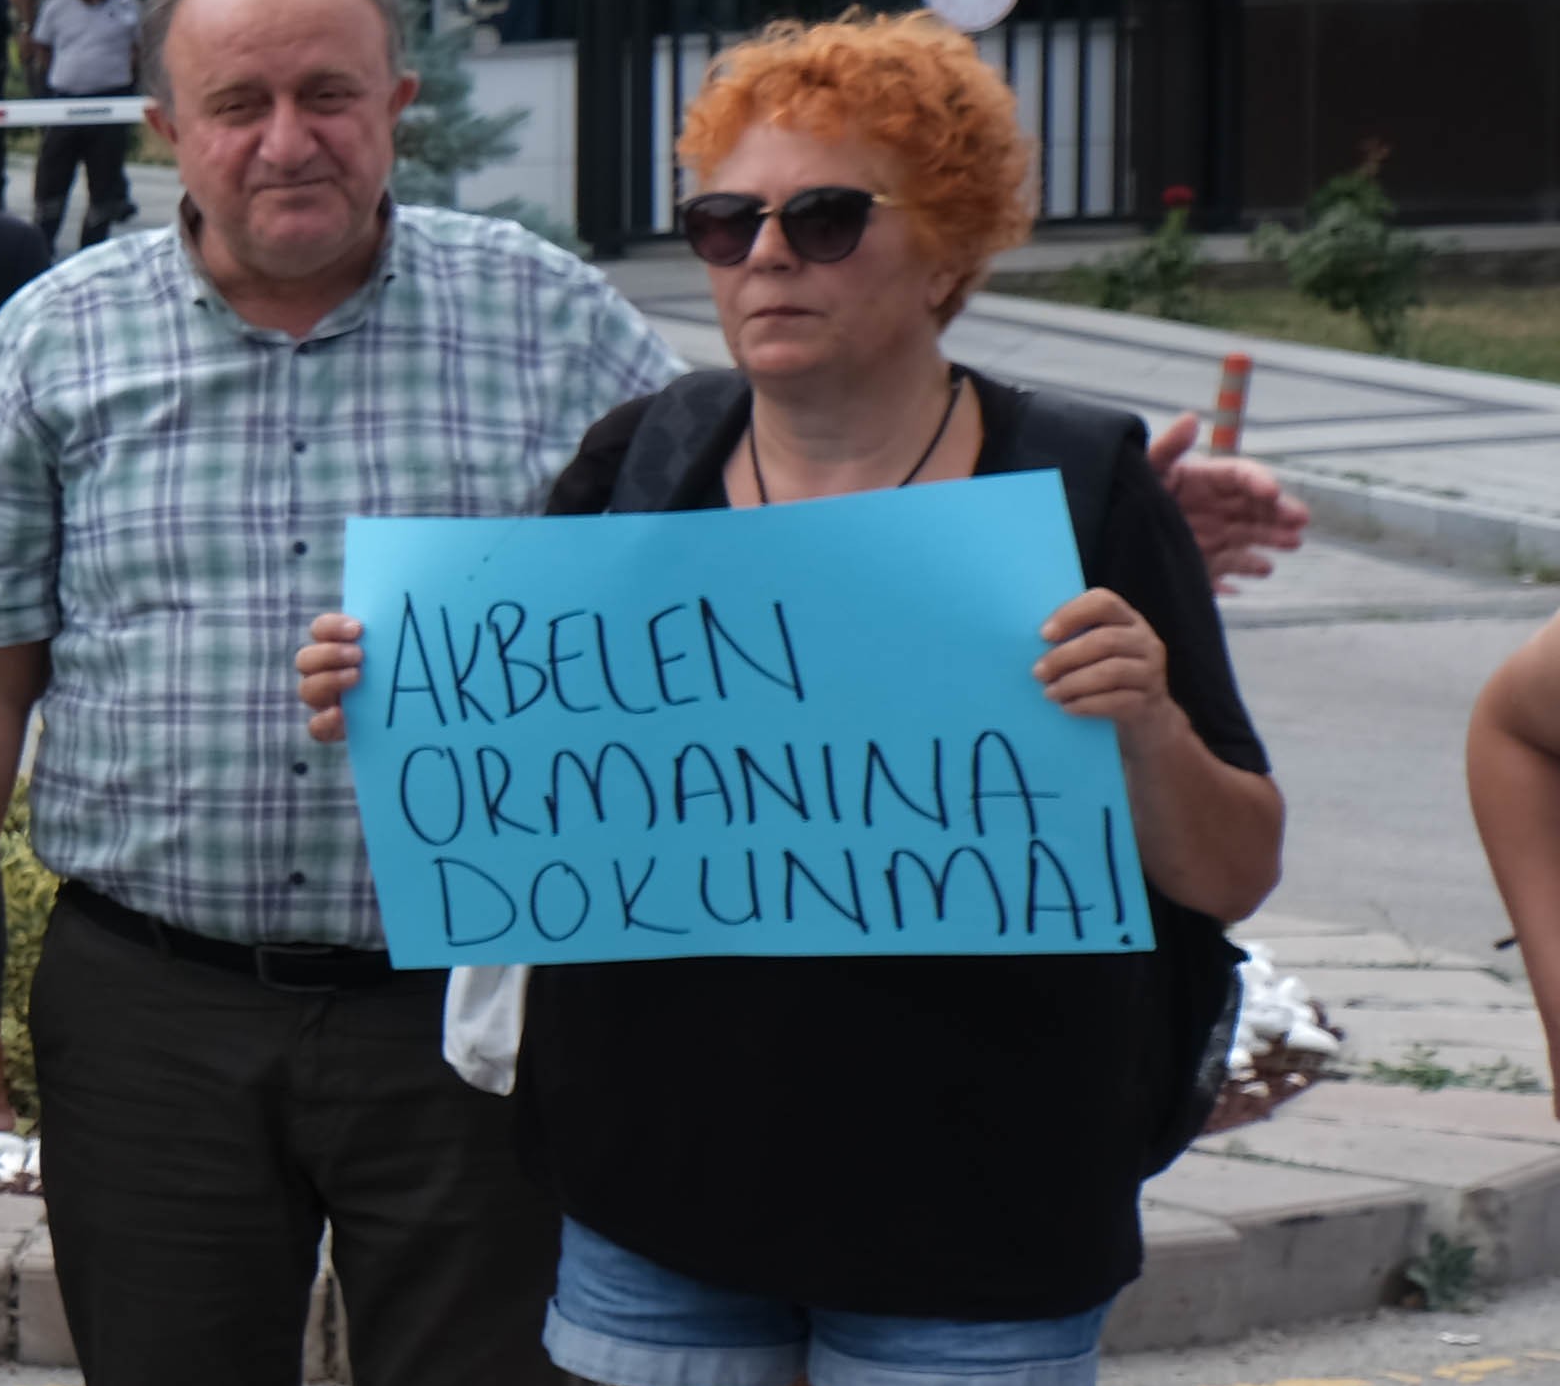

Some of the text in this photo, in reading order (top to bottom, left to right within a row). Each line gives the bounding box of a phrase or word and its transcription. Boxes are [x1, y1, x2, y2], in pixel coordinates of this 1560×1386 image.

[386, 592, 805, 728] AKBELEN
[400, 729, 1061, 846] ORMANINA
[433, 807, 1136, 947] DOKUNMA!
